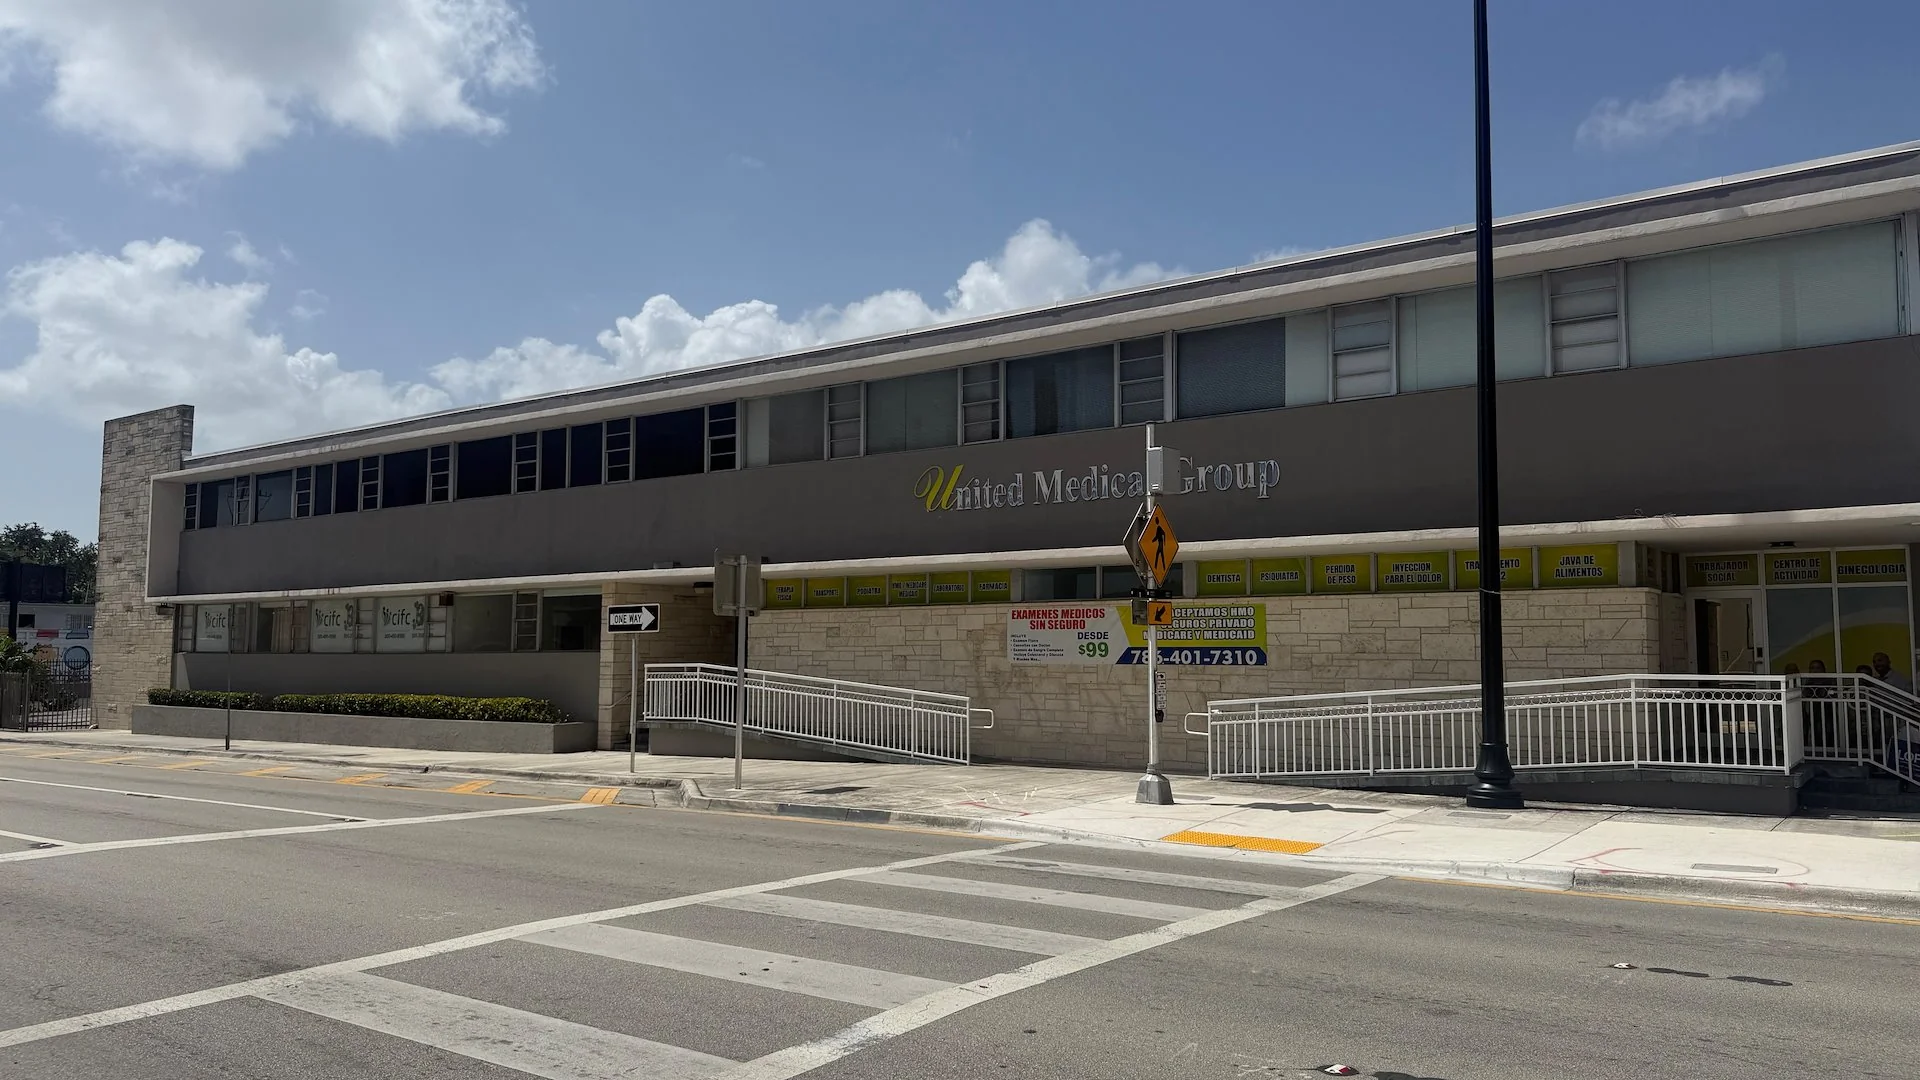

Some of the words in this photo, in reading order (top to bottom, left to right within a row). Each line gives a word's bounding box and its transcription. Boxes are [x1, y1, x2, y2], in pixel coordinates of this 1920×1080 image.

[914, 464, 1024, 512] United
[1033, 464, 1145, 505] Medica
[1465, 558, 1520, 570] TRAENTO
[1560, 556, 1582, 566] JAVA
[1584, 555, 1594, 565] DE
[1694, 561, 1748, 571] TRABAJADOR
[1774, 559, 1807, 569] CENTRO
[1809, 558, 1820, 568] DE
[1325, 564, 1355, 574] PERDIDA
[1392, 562, 1431, 572] INYECCION
[1555, 567, 1603, 578] ALIMENTOS
[1837, 563, 1905, 575] GINECOLOGIA
[1207, 574, 1241, 583] DENTISTA
[1260, 571, 1299, 581] PSIQUIATRA
[1327, 576, 1337, 585] DE
[1338, 575, 1356, 584] PESO
[1385, 574, 1404, 584] PARA
[1406, 574, 1415, 583] EL
[1416, 573, 1442, 583] DOLOR
[1707, 572, 1736, 582] SOCIAL
[1774, 569, 1819, 580] ACTIVIDAD
[979, 582, 1008, 591] FARMACIA
[392, 608, 411, 626] cifc
[1011, 609, 1059, 620] EXAMENES
[1061, 608, 1105, 619] MEDICOS
[1230, 607, 1254, 616] HMO
[323, 610, 341, 627] cifc
[614, 614, 627, 623] ONE
[629, 614, 641, 623] WAY
[1161, 619, 1209, 629] GUROS
[1209, 618, 1255, 628] PRIVADO
[1030, 619, 1046, 630] SIN
[1048, 619, 1086, 630] SEGURO
[1077, 631, 1109, 640] DESDE
[1143, 630, 1193, 640] MDICARE
[1194, 630, 1201, 640] Y
[1203, 629, 1255, 640] MEDICAID
[1078, 641, 1109, 658] $99
